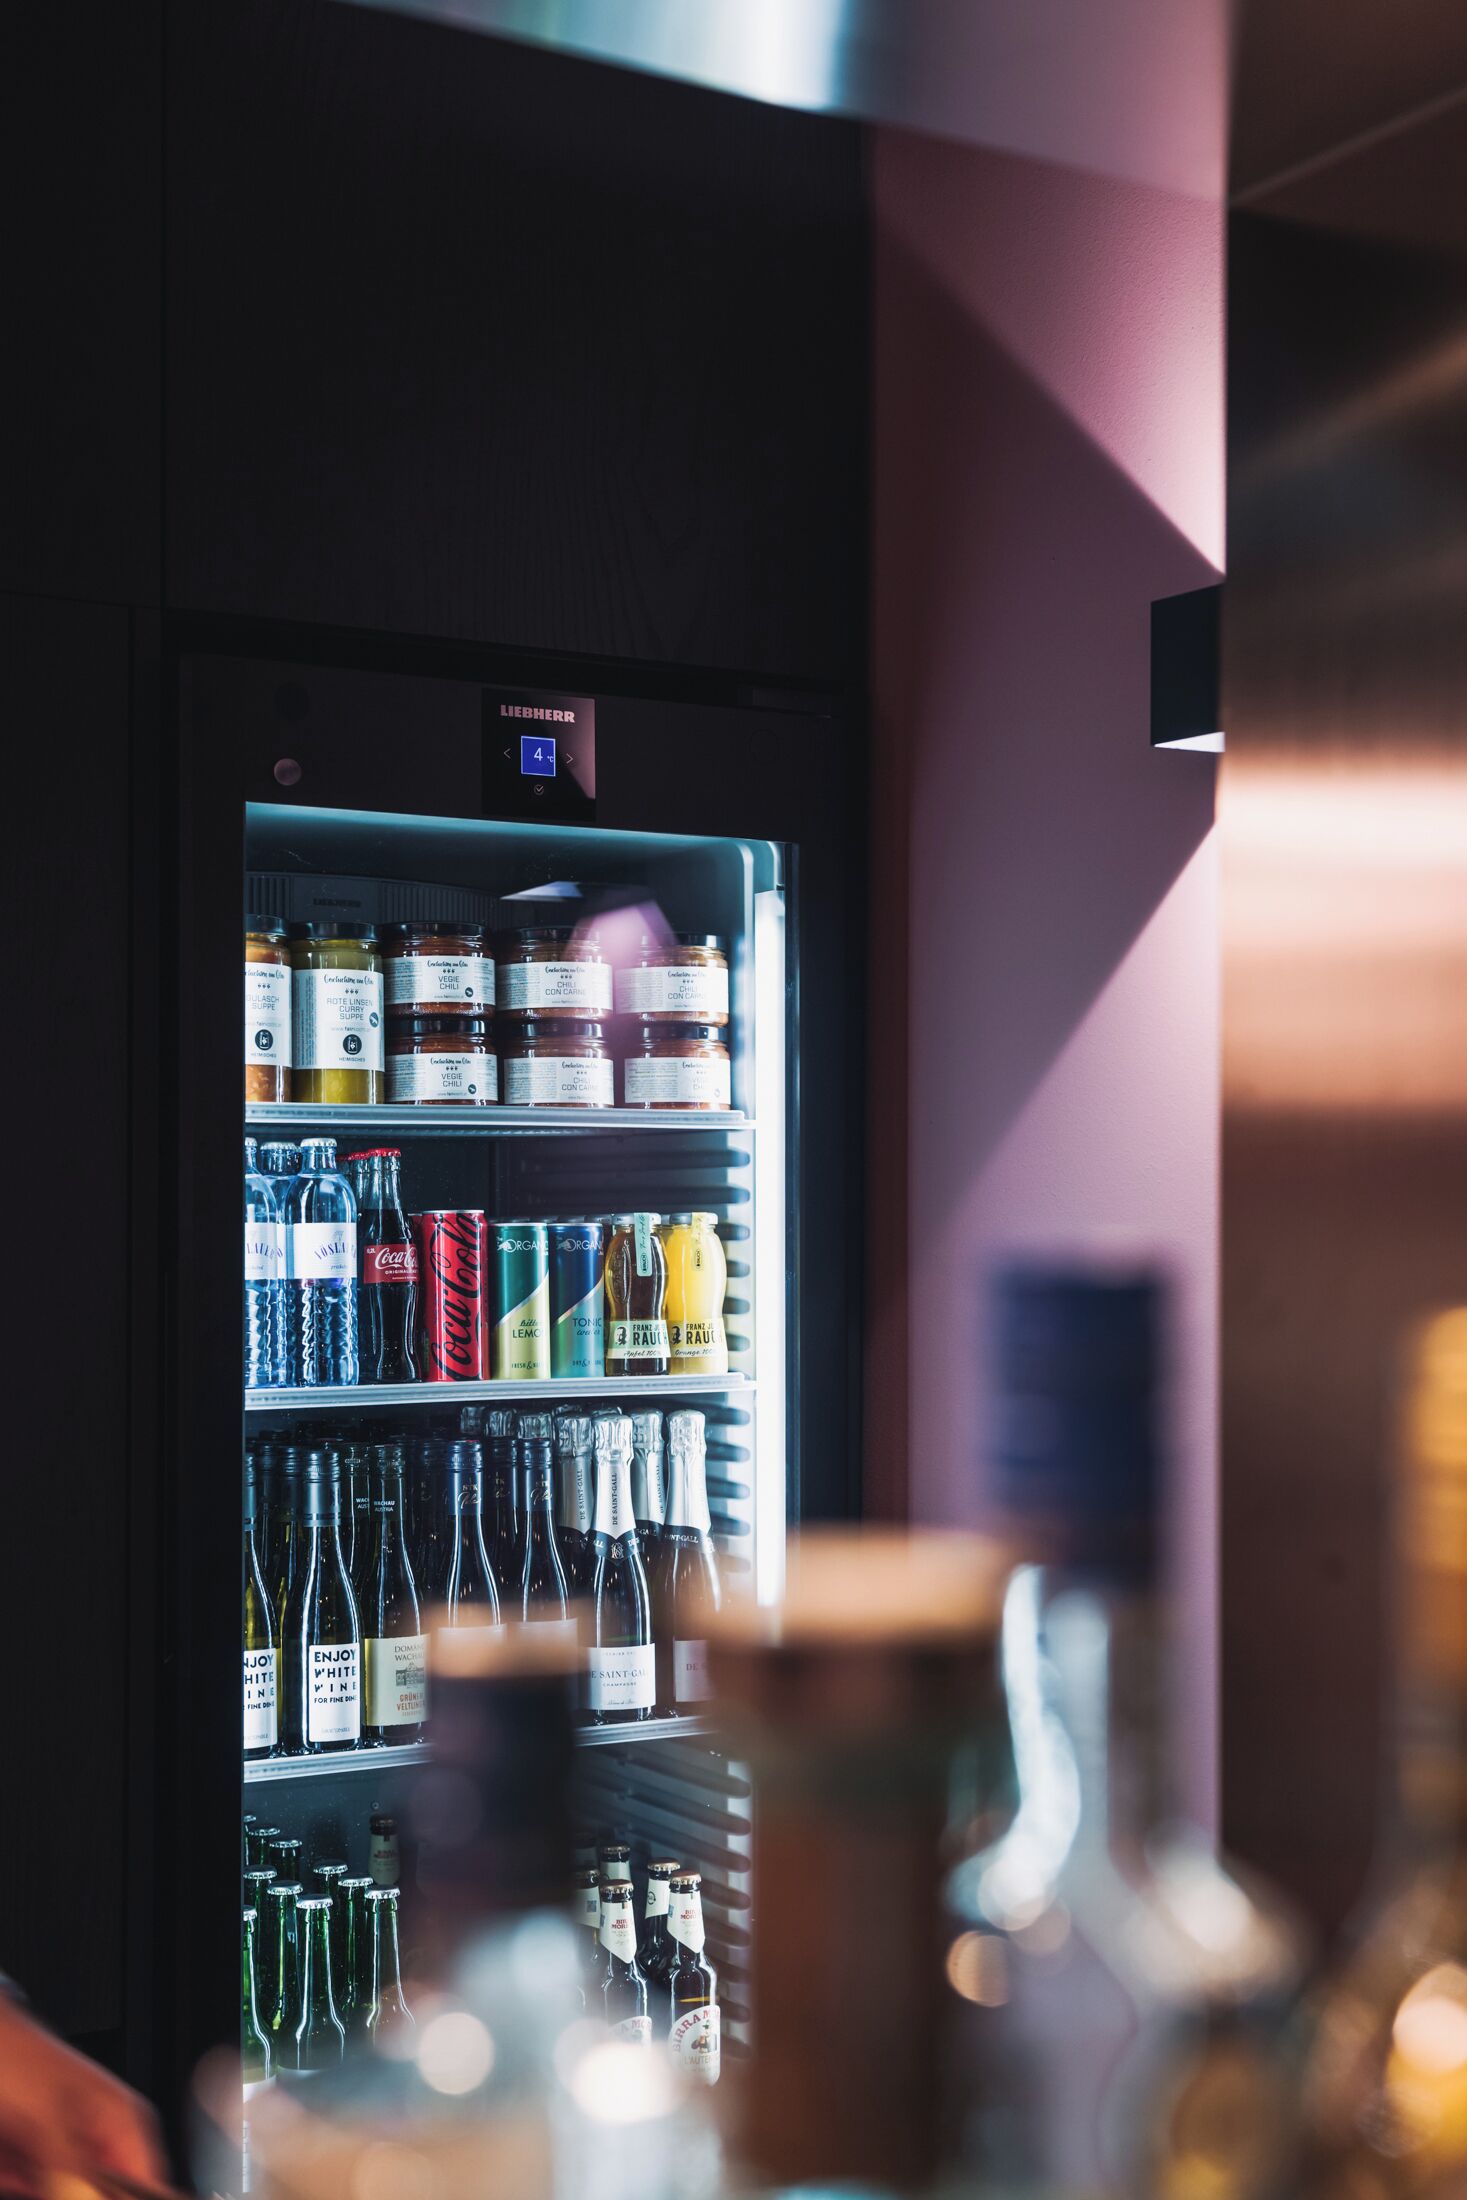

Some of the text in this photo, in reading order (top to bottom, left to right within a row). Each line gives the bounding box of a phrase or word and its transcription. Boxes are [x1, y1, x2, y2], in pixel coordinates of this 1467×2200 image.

[500, 704, 576, 723] LIEBHERR
[533, 747, 543, 762] 4
[350, 998, 373, 1006] LINSEN
[430, 1213, 482, 1381] Coca-Cola
[572, 1317, 602, 1327] TONIC
[633, 1323, 652, 1331] FRANZ
[512, 1328, 542, 1338] LEMO
[686, 1331, 716, 1345] RAUC
[612, 1515, 618, 1526] DE
[314, 1649, 355, 1662] ENJOY
[314, 1666, 357, 1678] WHITE
[600, 1669, 648, 1679] SAINT-GAL
[314, 1681, 357, 1693] WINE
[248, 1702, 261, 1710] FINE
[673, 2013, 703, 2053] BIRRA
